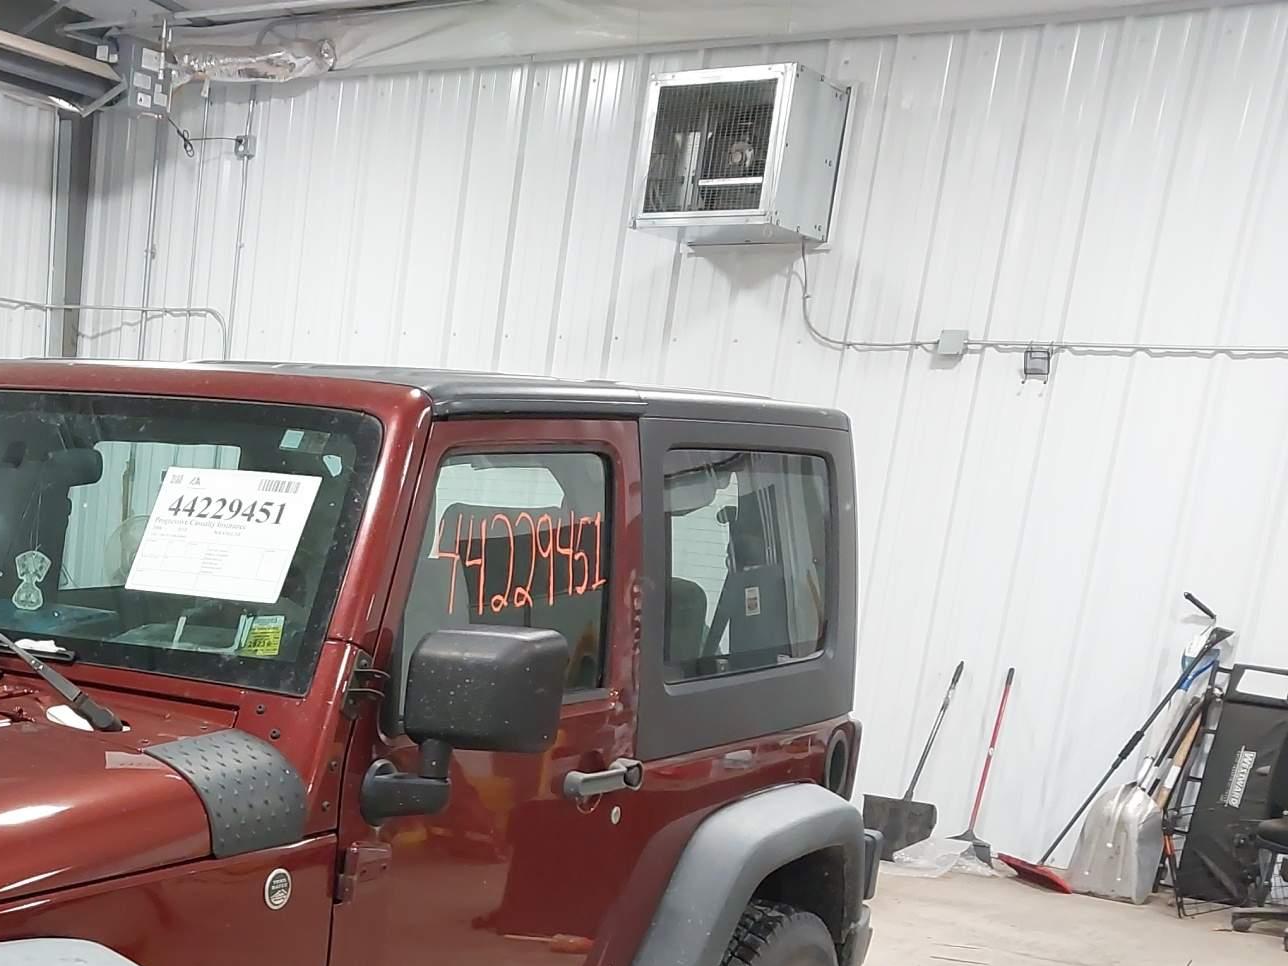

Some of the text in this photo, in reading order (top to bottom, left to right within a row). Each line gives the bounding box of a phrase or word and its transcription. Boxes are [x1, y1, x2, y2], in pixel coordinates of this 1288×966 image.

[168, 494, 287, 525] 44229451
[437, 511, 606, 615] 44229451
[1229, 751, 1255, 806] WESTWARD
